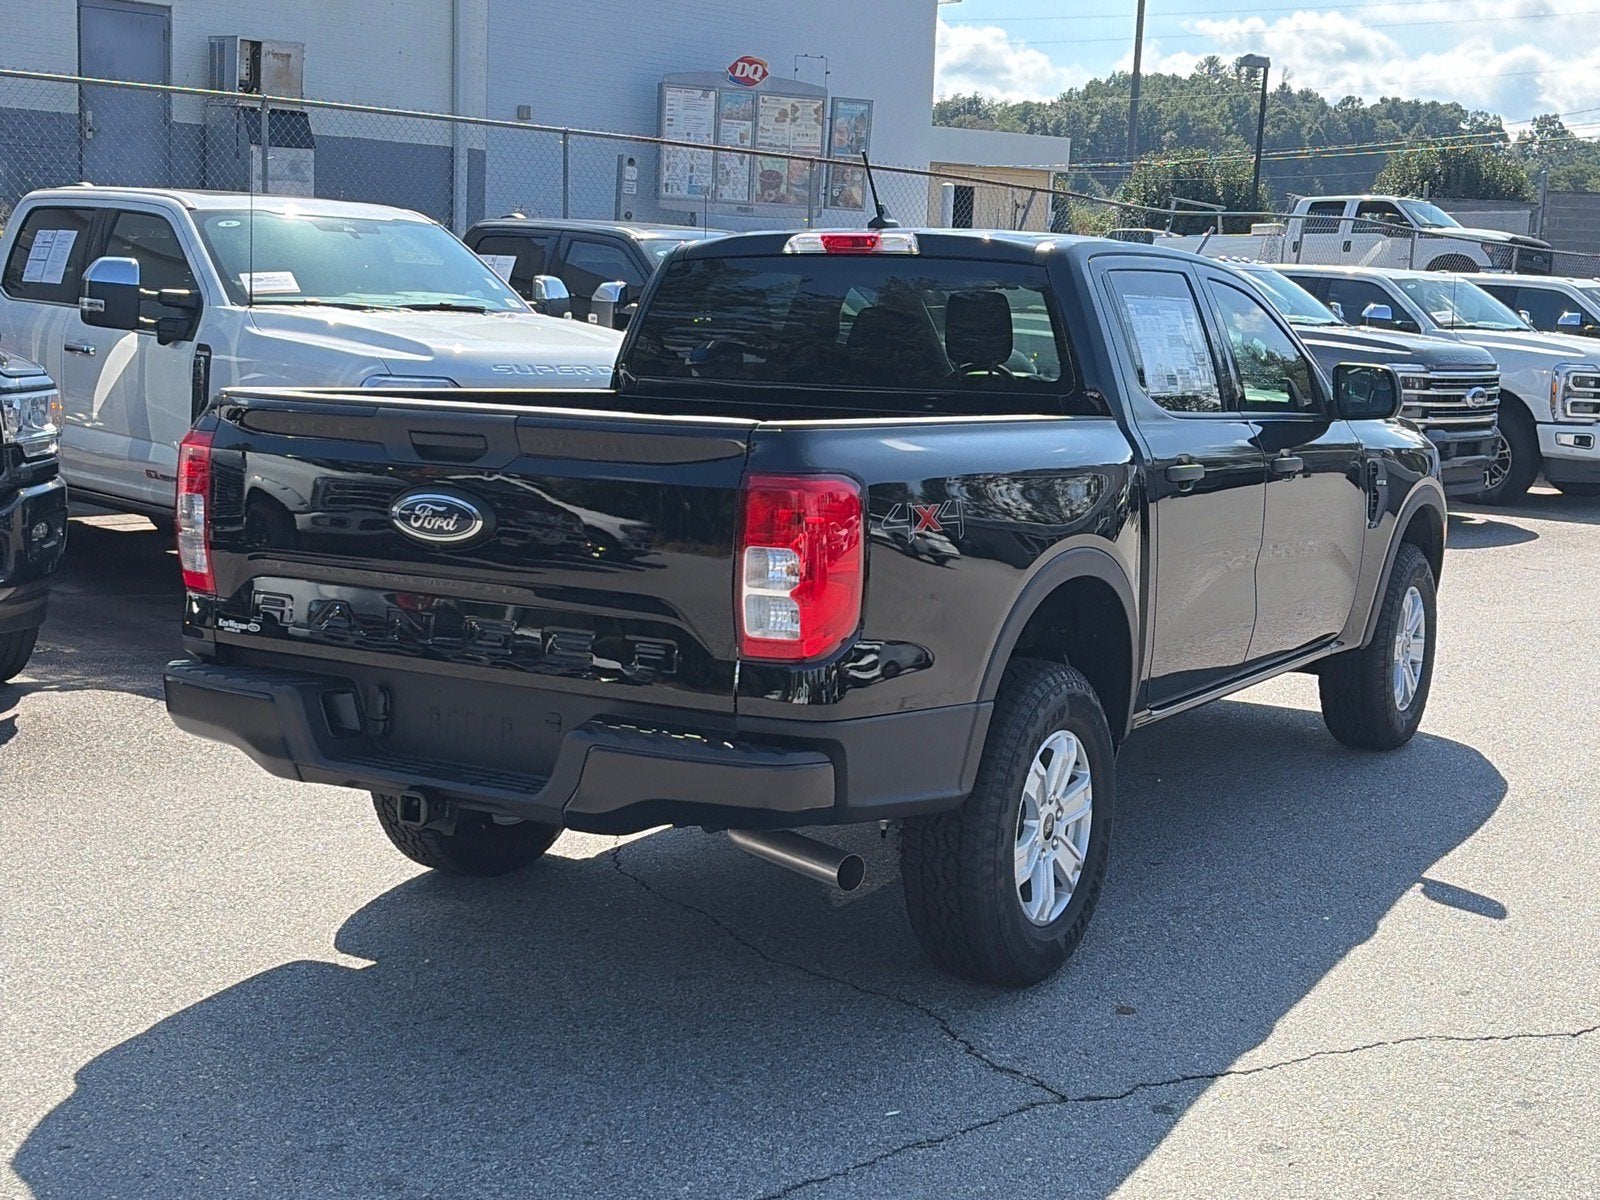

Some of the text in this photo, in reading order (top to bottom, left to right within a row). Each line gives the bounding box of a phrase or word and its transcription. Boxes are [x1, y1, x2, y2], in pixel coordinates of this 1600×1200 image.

[735, 62, 764, 81] DQ
[492, 364, 594, 375] SUPER
[252, 590, 680, 674] RANGER
